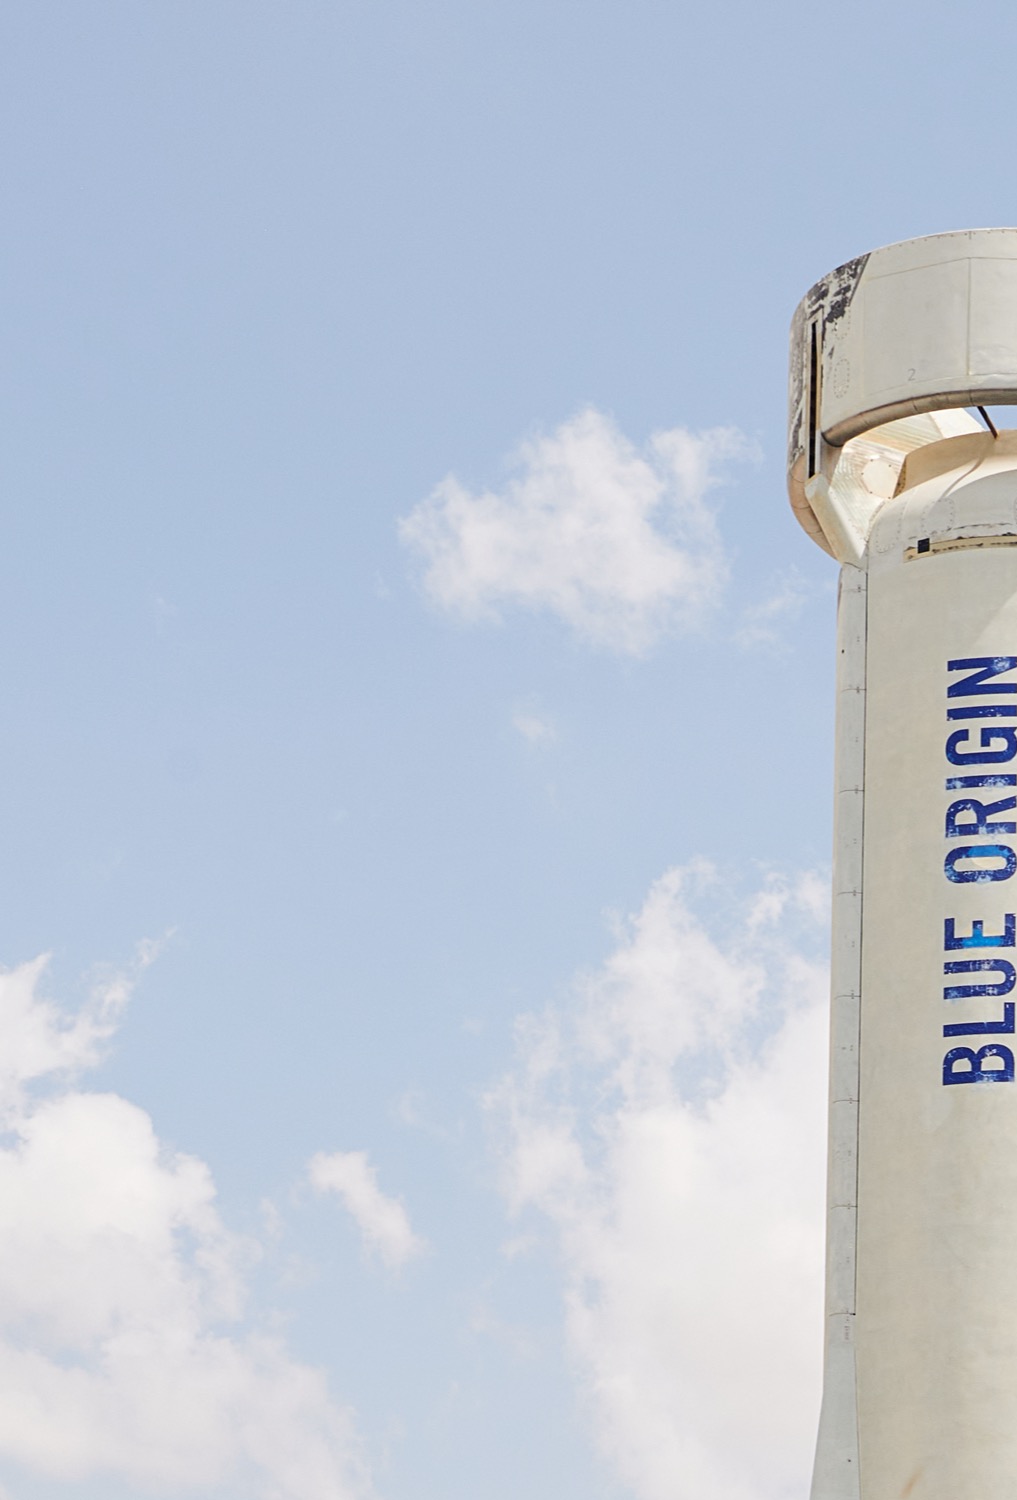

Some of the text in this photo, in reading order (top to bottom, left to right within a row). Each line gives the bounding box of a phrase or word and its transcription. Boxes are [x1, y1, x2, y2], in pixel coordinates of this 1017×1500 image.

[907, 367, 916, 381] 2
[942, 656, 1017, 1085] BLUE ORIGIN
